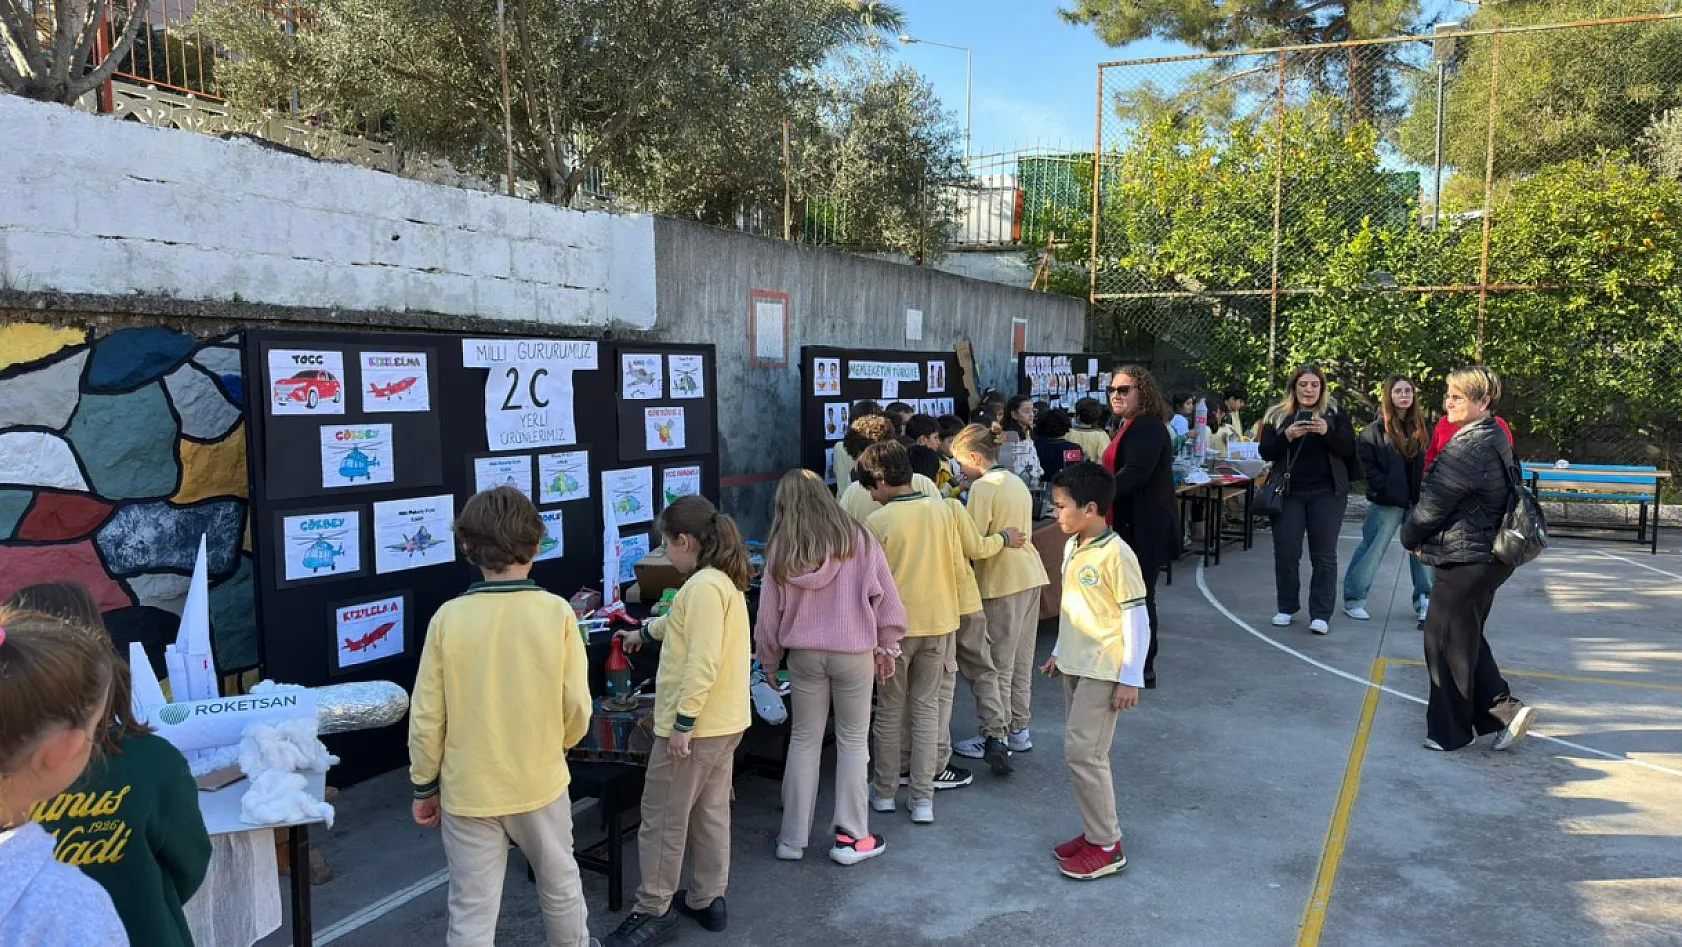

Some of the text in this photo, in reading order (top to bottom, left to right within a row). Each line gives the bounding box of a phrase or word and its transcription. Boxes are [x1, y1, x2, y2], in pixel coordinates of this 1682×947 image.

[501, 367, 550, 411] 2 C
[195, 695, 297, 715] ROKETSAN
[28, 785, 131, 823] unus
